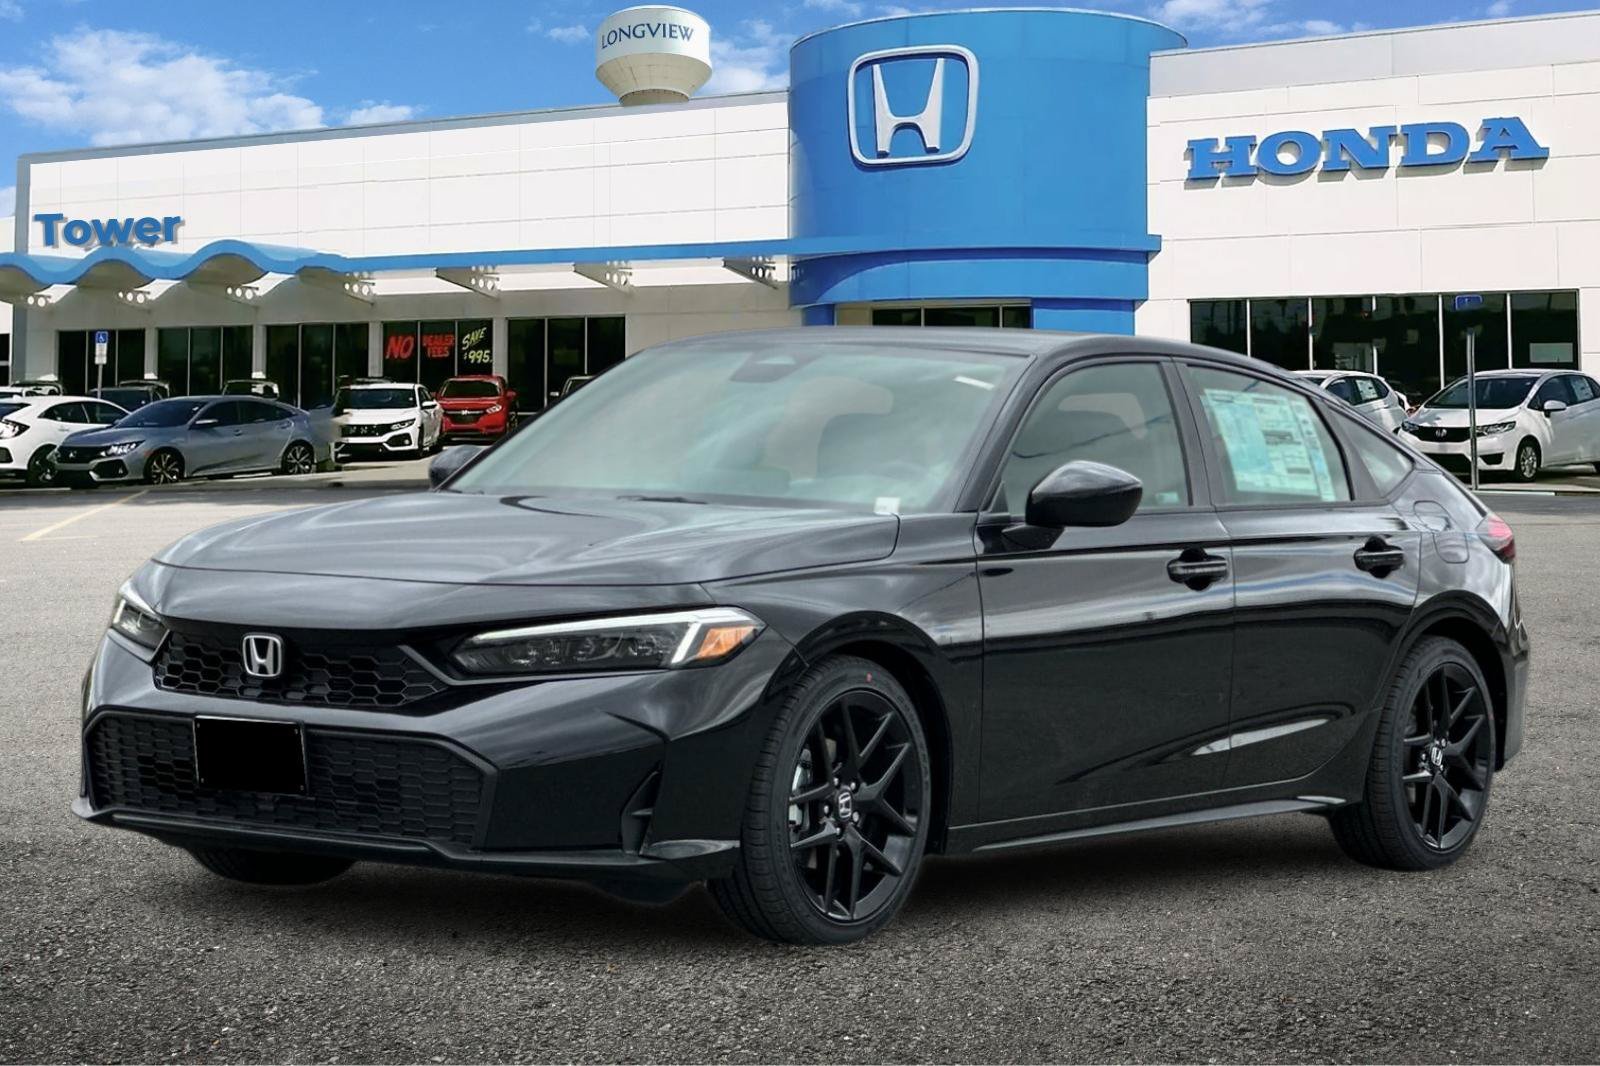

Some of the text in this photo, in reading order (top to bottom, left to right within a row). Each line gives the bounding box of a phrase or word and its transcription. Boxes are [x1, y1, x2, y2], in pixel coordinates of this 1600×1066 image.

[601, 23, 694, 49] LONGVIEW
[1186, 116, 1550, 182] HONDA
[34, 213, 182, 247] Tower
[385, 335, 415, 359] NO
[461, 327, 487, 350] SAVE
